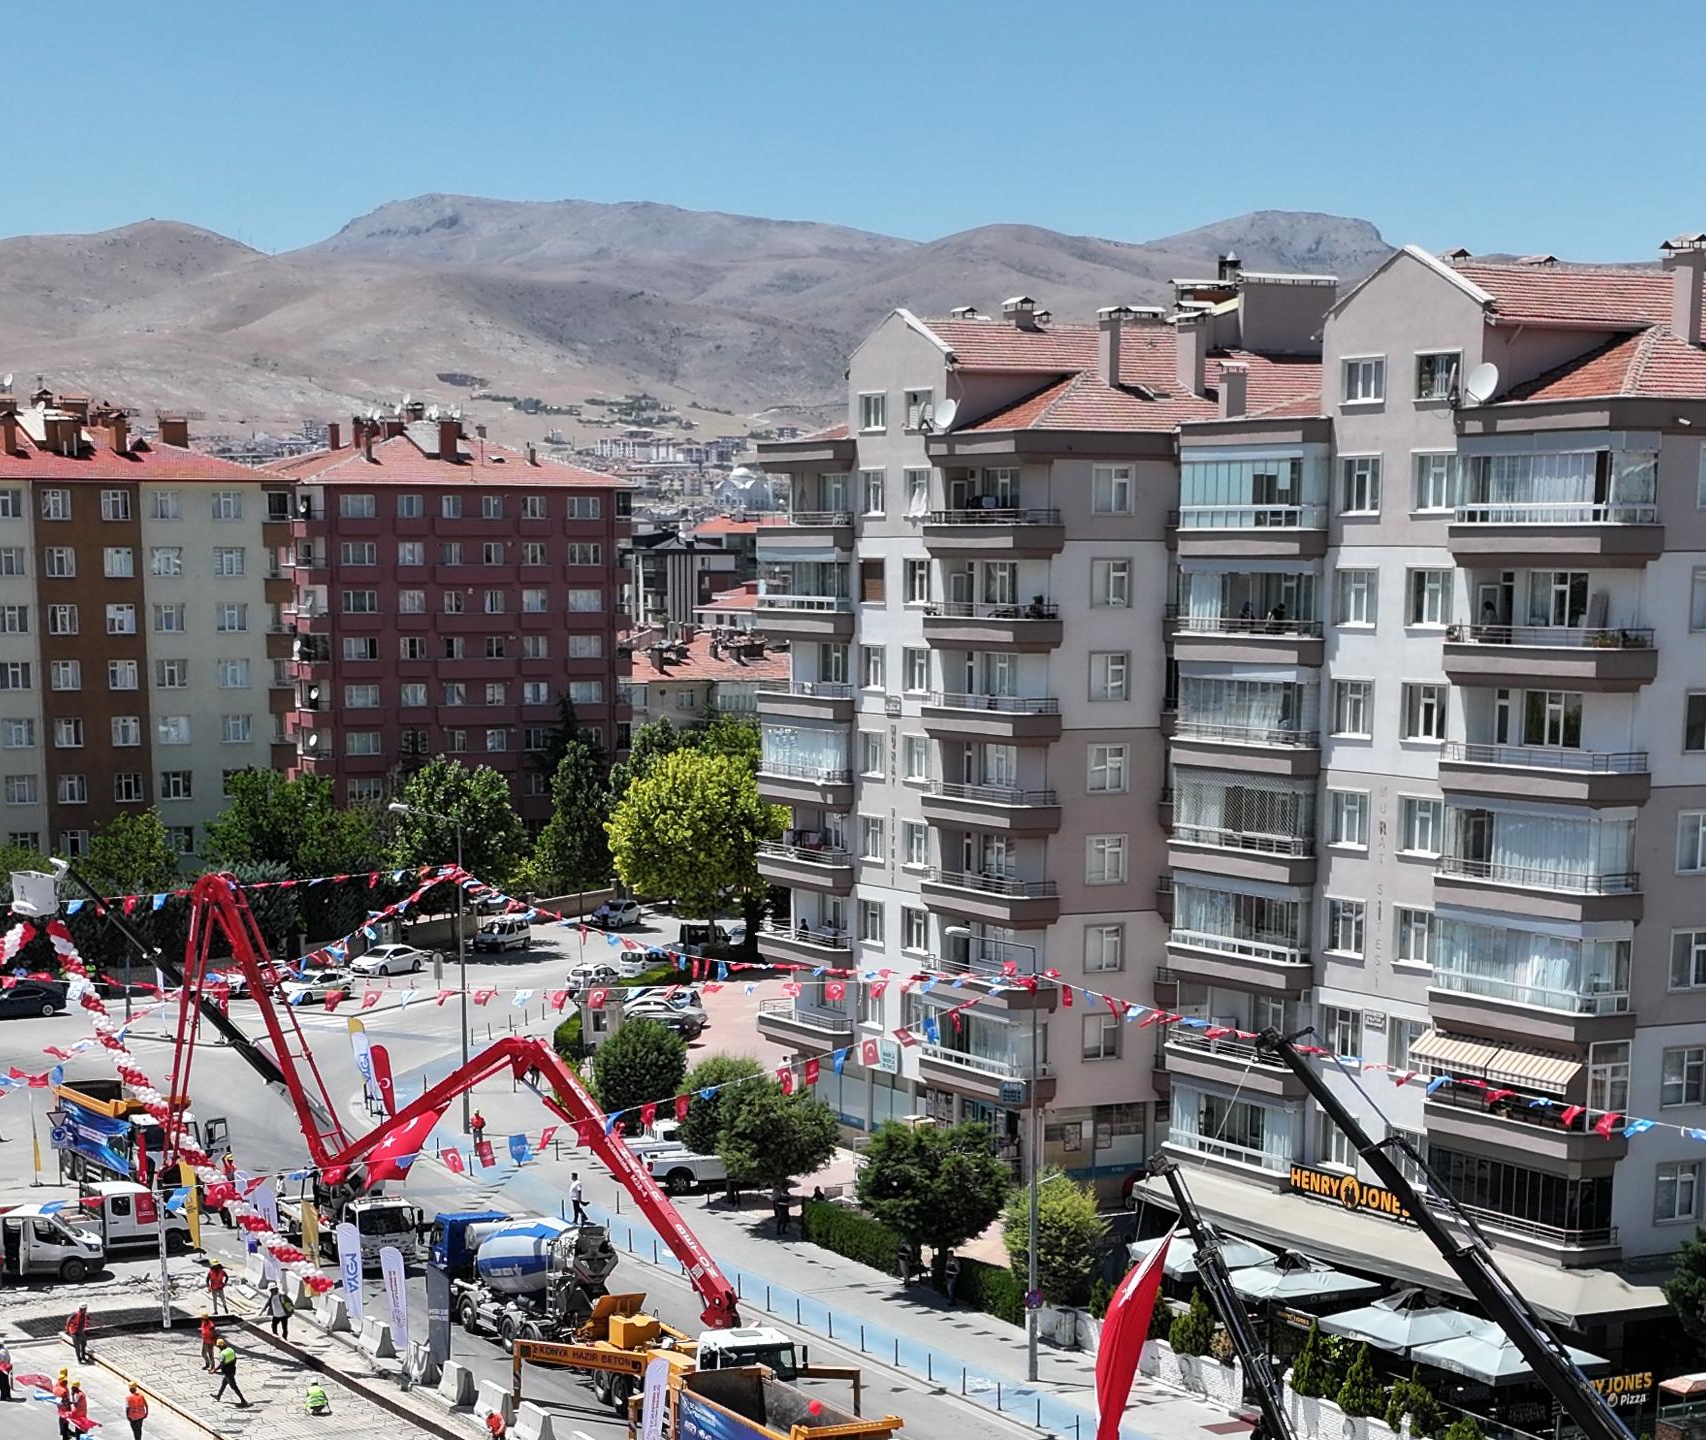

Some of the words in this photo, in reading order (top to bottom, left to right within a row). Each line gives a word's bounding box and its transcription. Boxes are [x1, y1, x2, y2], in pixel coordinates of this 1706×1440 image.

[1290, 1167, 1340, 1198] HENRY
[601, 1354, 632, 1366] BETON
[1607, 1372, 1653, 1393] JONES
[1620, 1393, 1647, 1406] Pizza
